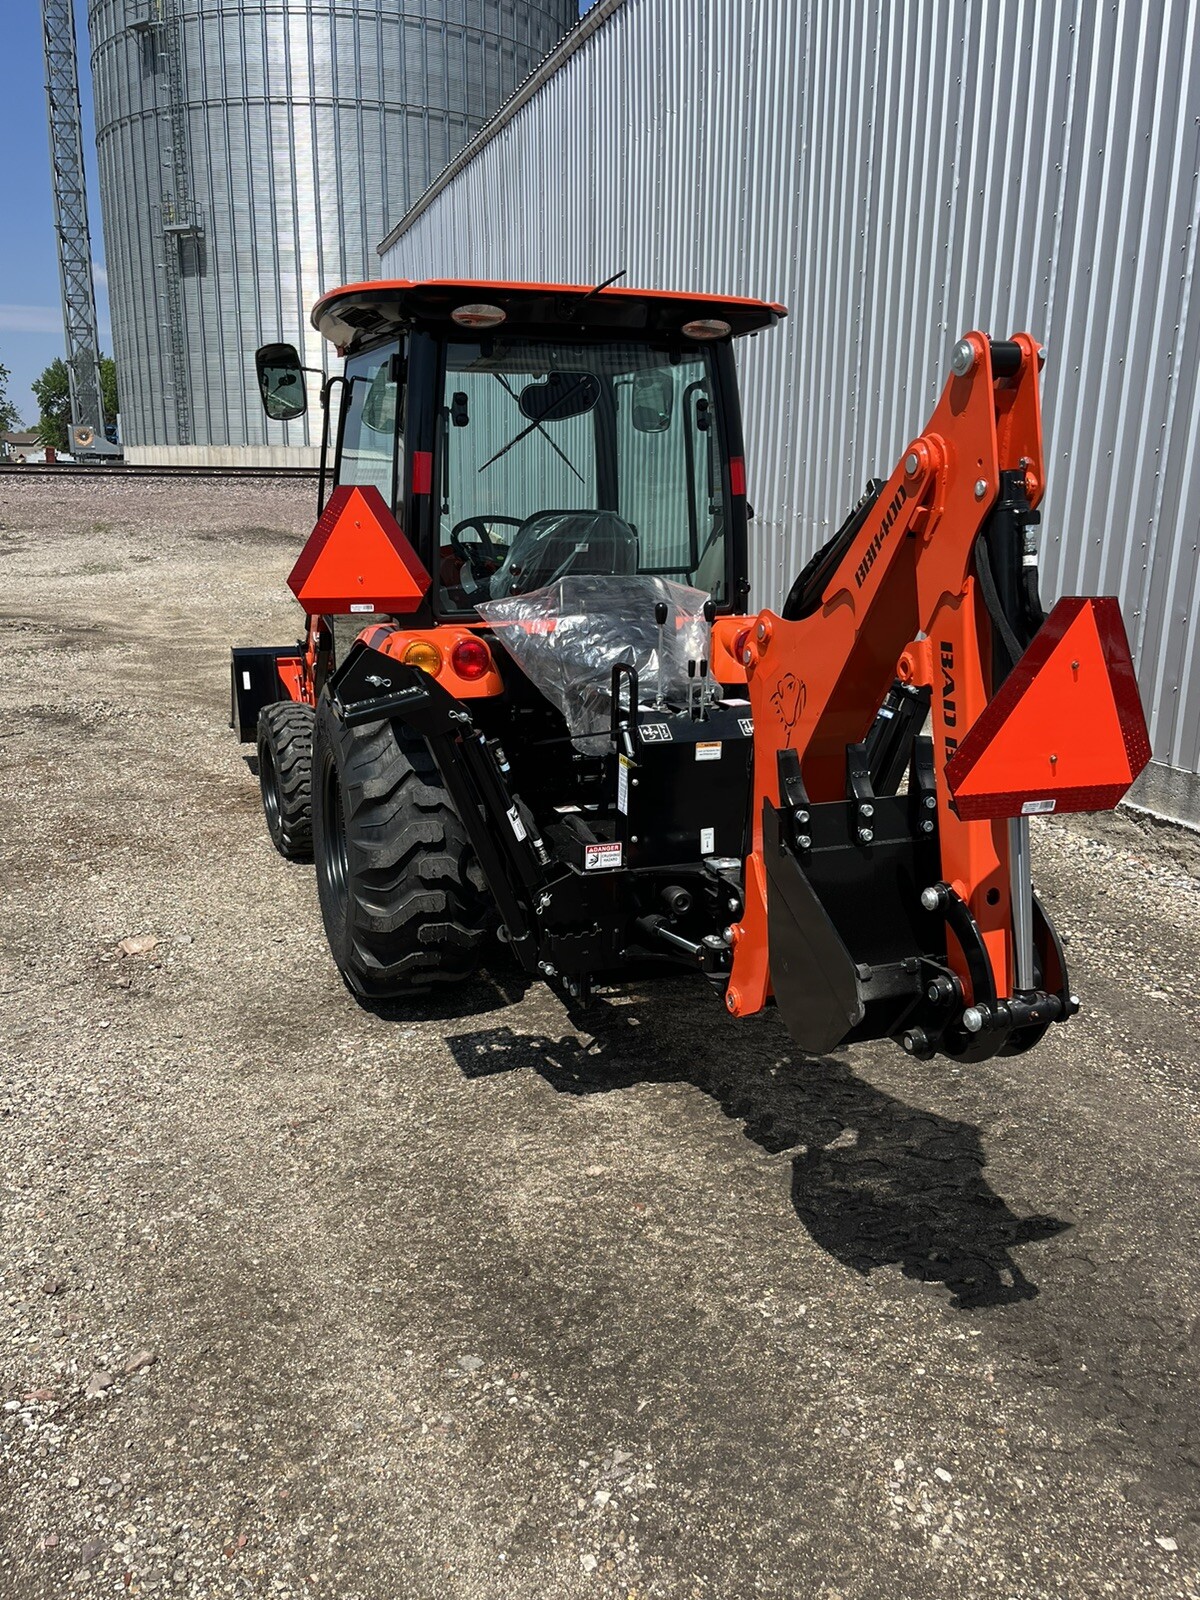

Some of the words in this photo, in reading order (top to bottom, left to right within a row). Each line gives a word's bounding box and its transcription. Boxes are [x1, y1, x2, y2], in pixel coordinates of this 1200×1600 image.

[854, 484, 907, 589] BBH400
[940, 641, 957, 728] BAD
[594, 845, 619, 853] DANGER
